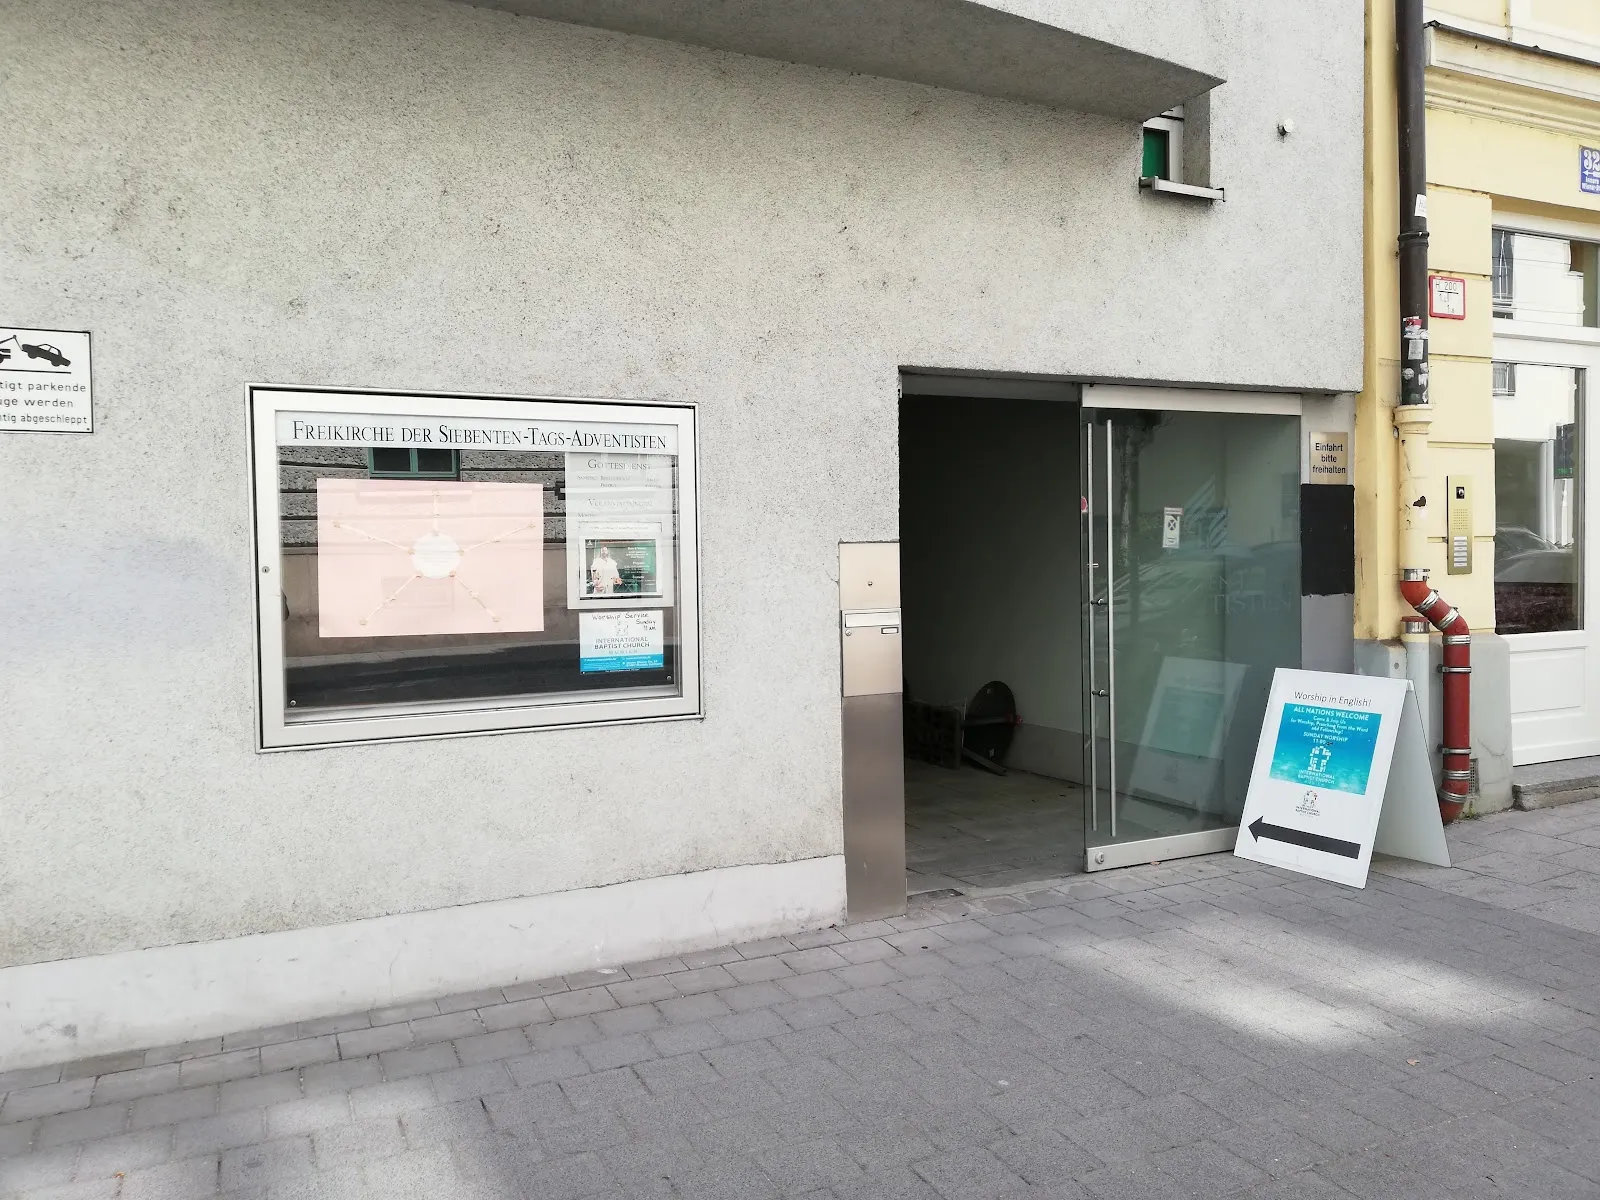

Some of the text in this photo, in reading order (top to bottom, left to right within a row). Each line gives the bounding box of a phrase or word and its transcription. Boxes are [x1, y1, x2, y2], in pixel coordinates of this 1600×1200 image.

[1583, 149, 1600, 172] 32
[1444, 281, 1458, 291] 200
[27, 382, 86, 393] parkende
[24, 398, 74, 408] werden
[0, 413, 88, 425] tig abgeschleppt
[292, 420, 394, 442] FREIKIRCHE
[401, 426, 433, 443] DER
[1315, 442, 1344, 452] Einfahrt
[1321, 454, 1338, 463] bitte
[1312, 464, 1346, 474] freihalten
[624, 611, 649, 619] Service
[595, 636, 649, 644] INTERNATIONAL
[594, 642, 621, 650] BAPTIST
[1294, 690, 1372, 708] Worship in English!
[1305, 707, 1335, 717] NATIONS
[1335, 711, 1370, 721] WELCOME
[1303, 731, 1349, 743] SUNDAY WORSHIP
